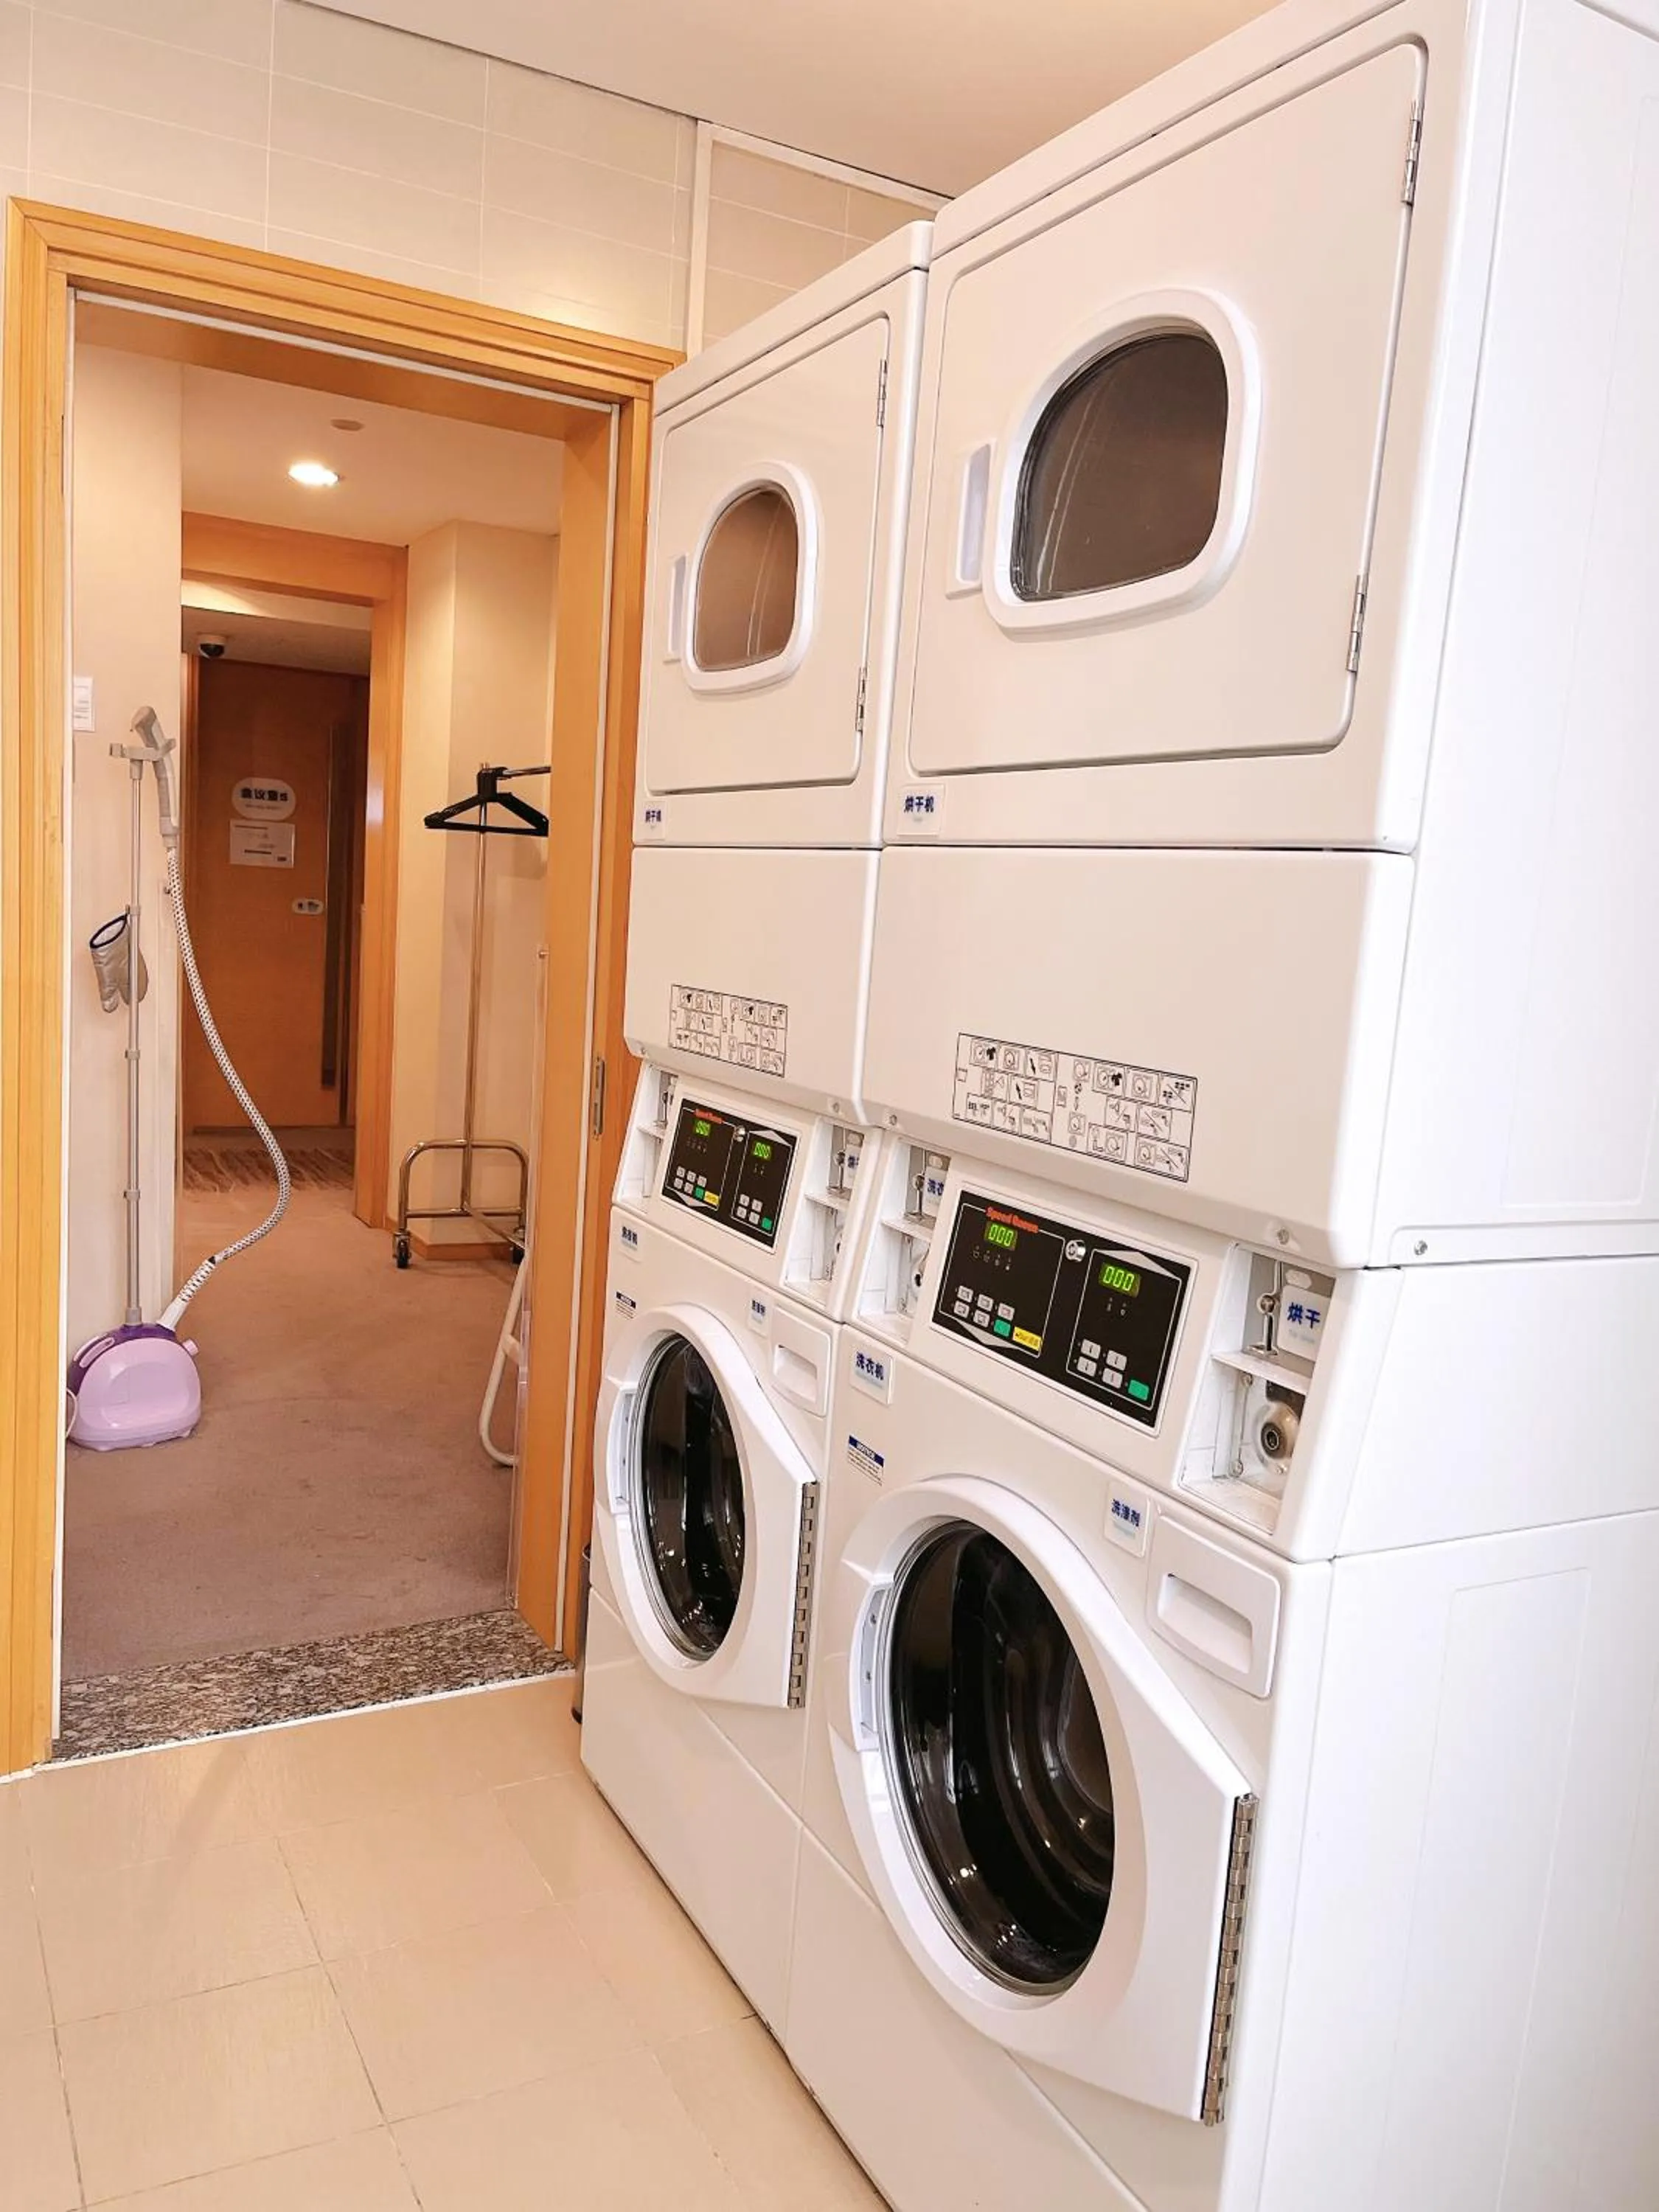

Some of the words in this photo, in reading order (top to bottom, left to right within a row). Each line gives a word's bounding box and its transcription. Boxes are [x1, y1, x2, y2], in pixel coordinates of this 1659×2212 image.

[988, 1224, 1014, 1247] 000
[1102, 1265, 1135, 1291] 000
[1287, 1301, 1321, 1329] 烘干
